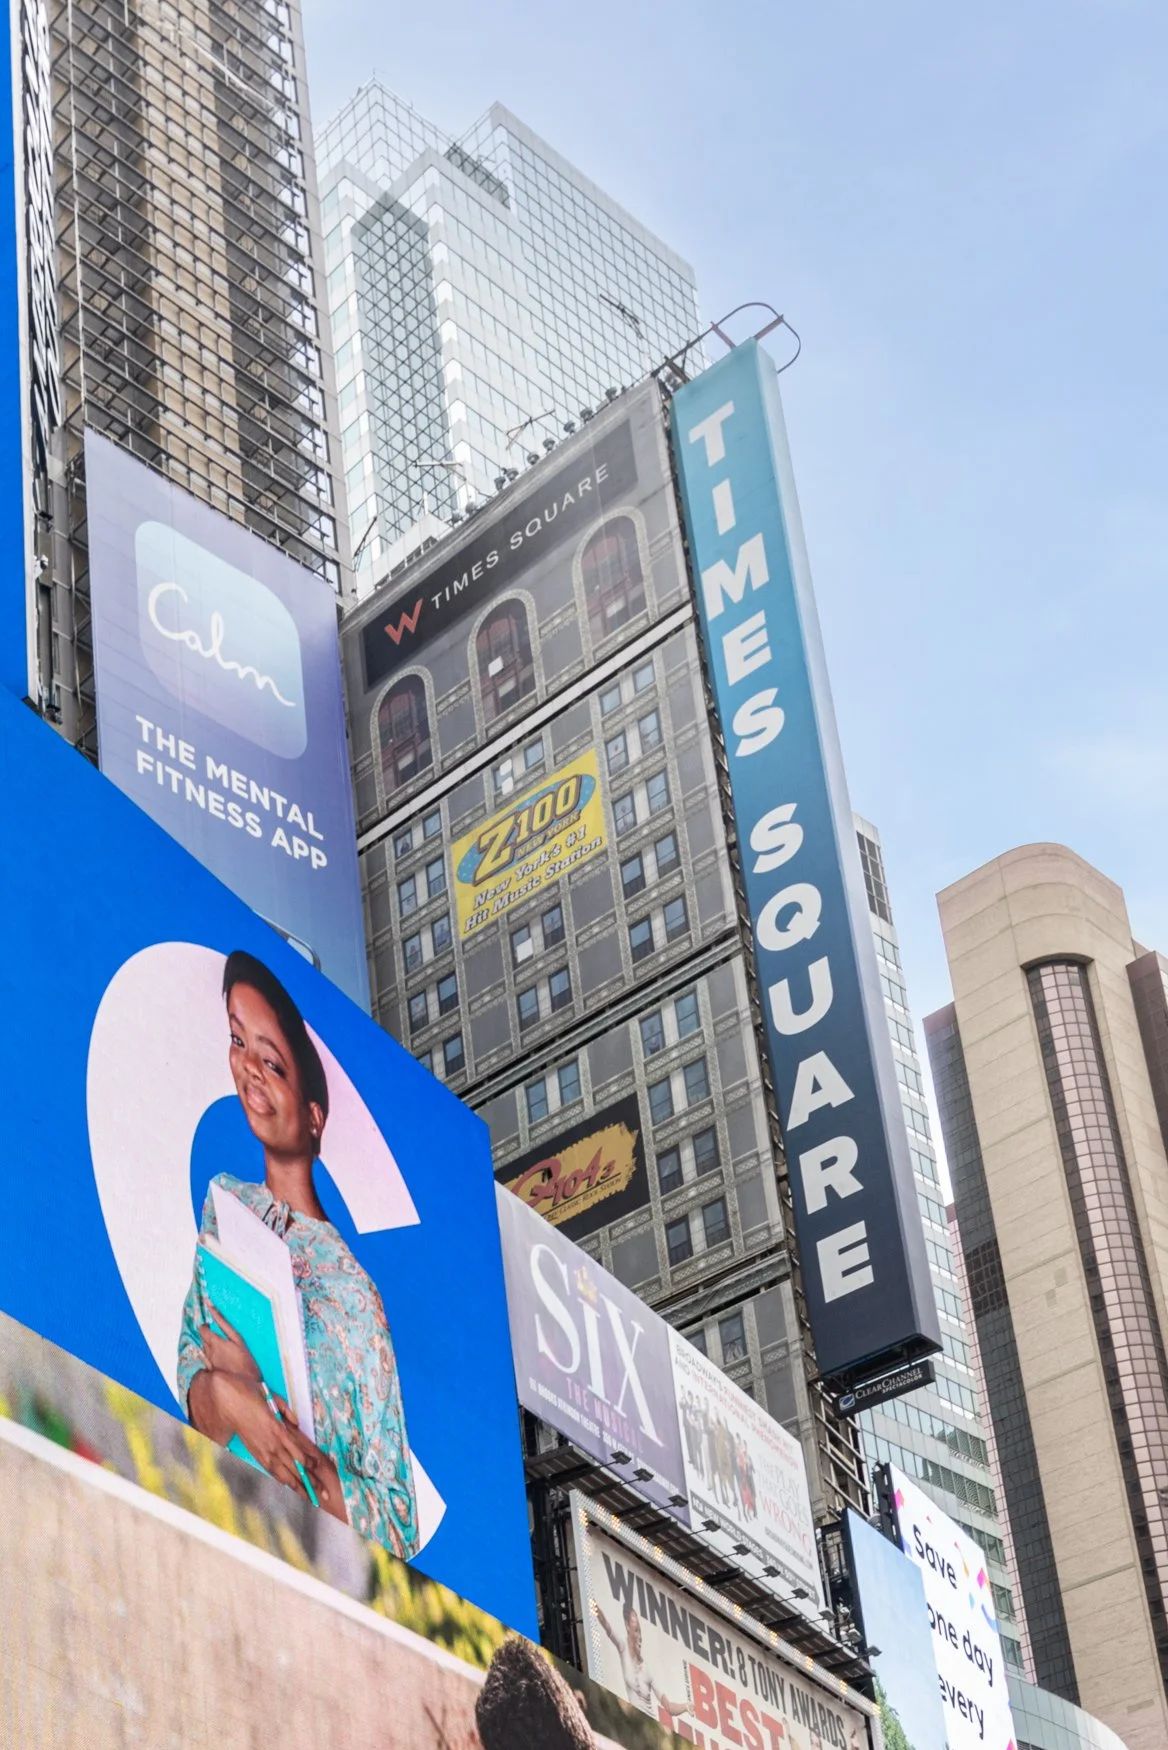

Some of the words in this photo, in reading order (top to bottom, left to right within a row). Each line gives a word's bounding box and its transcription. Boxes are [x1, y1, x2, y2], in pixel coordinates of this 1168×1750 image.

[384, 598, 423, 645] W
[431, 550, 499, 609] TIMES
[510, 463, 609, 550] SQUARE
[148, 577, 296, 706] Calm
[136, 715, 196, 770] THE
[206, 756, 323, 840] MENTAL
[136, 749, 262, 838] FITNESS
[271, 828, 328, 869] APP
[473, 774, 582, 887] Z100
[464, 910, 489, 933] Hit
[492, 877, 541, 914] Music
[545, 836, 602, 880] Station
[473, 878, 511, 910] New
[515, 843, 561, 882] York's
[565, 824, 587, 848] #1
[689, 401, 785, 757] TIMES
[750, 803, 874, 1303] SQUARE
[913, 1524, 957, 1590] Save
[601, 1551, 736, 1680] WINNER!
[737, 1646, 749, 1688] 8
[749, 1655, 787, 1715] TONY
[927, 1602, 959, 1650] one
[963, 1630, 993, 1687] day
[938, 1674, 984, 1740] every
